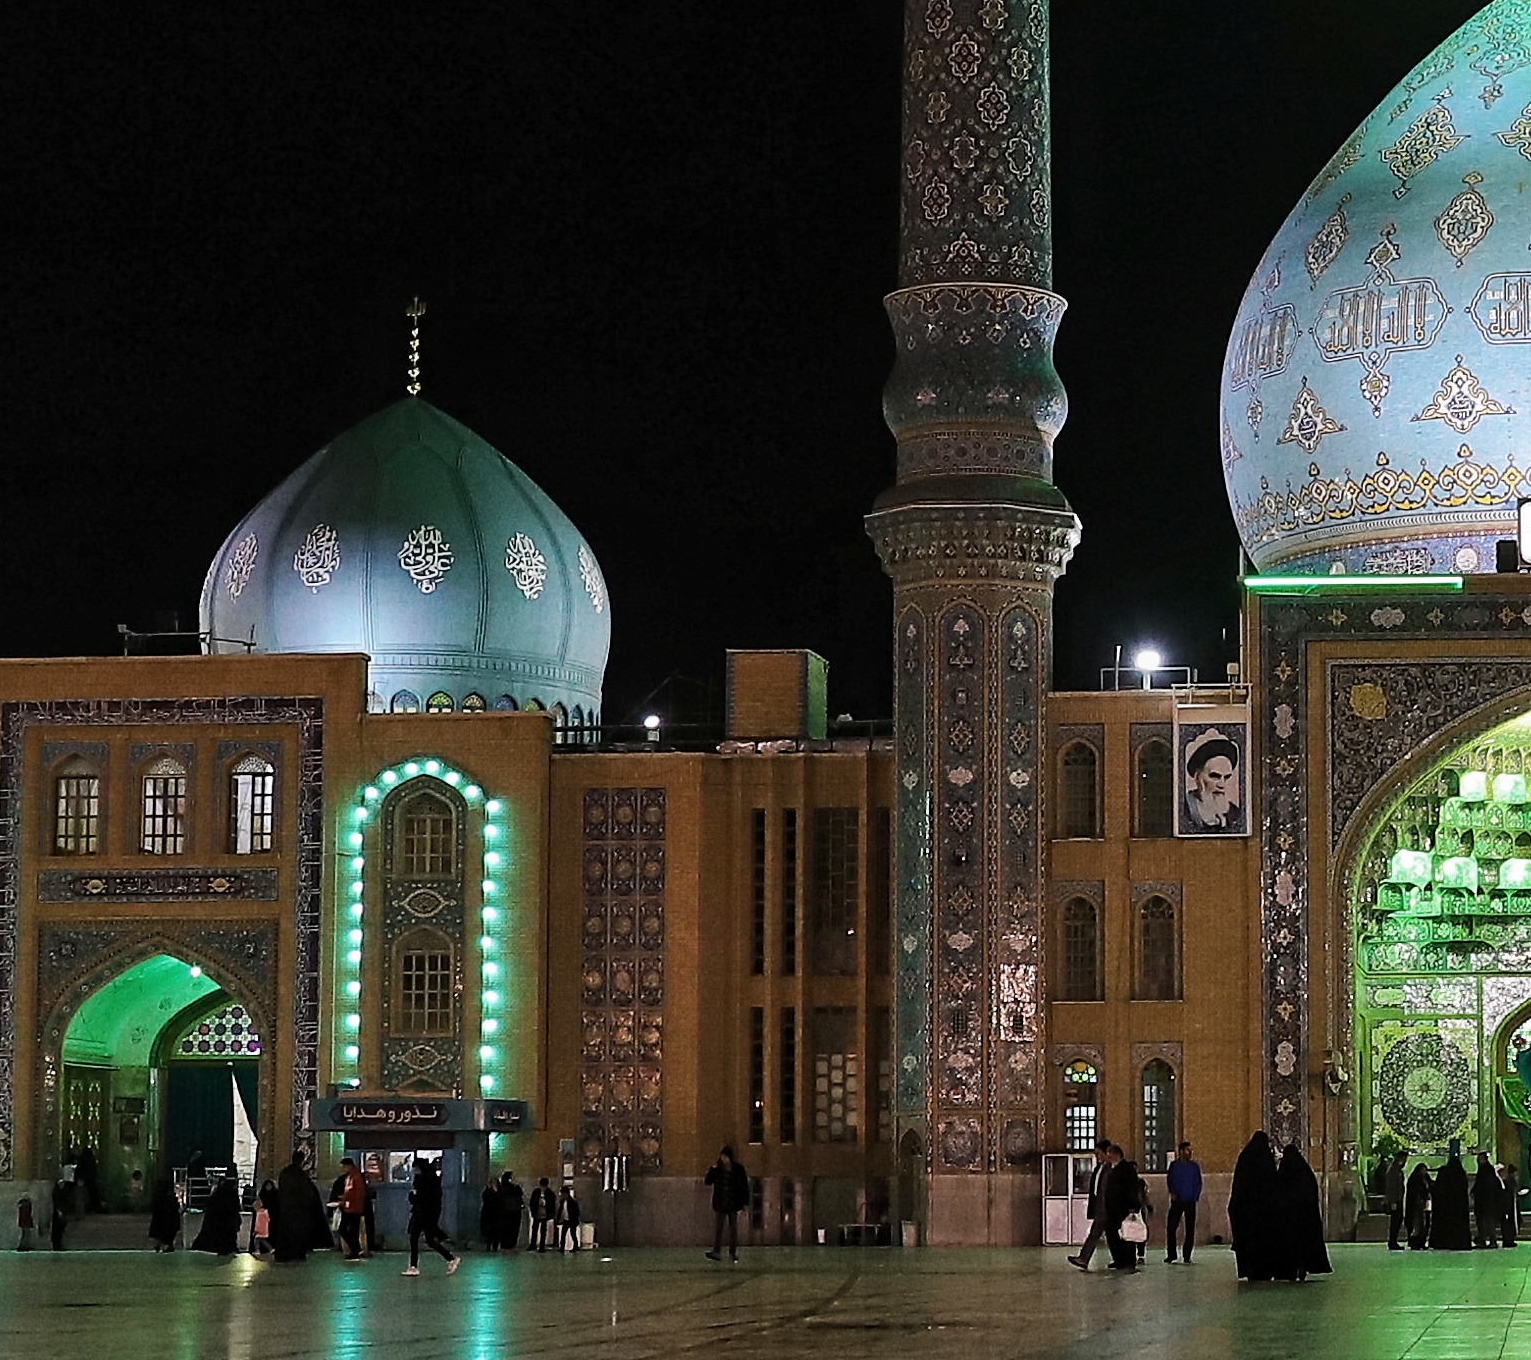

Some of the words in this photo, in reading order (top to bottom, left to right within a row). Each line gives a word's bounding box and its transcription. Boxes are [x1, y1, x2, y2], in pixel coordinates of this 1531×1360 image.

[343, 1105, 387, 1122] هدایا
[387, 1111, 396, 1123] و
[396, 1105, 438, 1123] نذور
